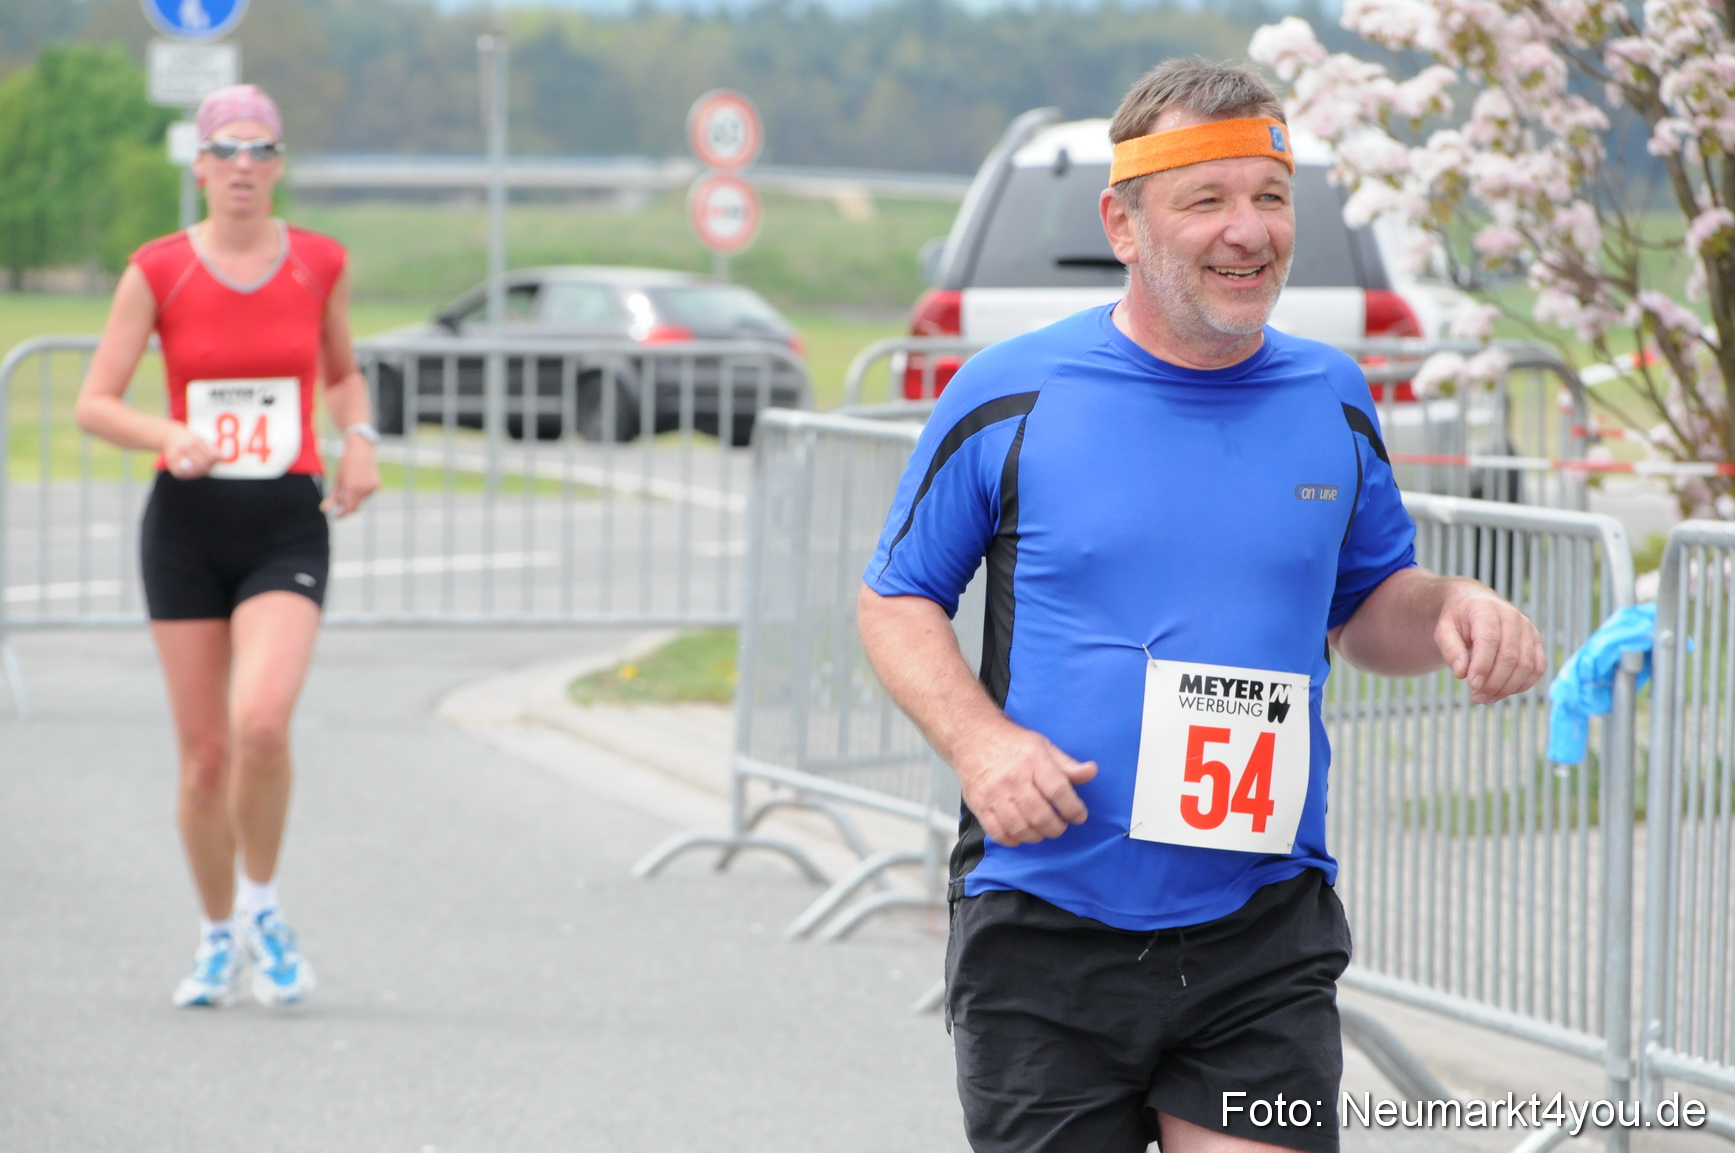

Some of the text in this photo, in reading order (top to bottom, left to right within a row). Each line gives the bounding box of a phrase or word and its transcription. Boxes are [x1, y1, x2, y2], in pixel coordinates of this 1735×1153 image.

[216, 411, 272, 464] 84
[1179, 673, 1264, 701] MEYER
[1179, 695, 1263, 717] WERBUNG
[1180, 724, 1276, 833] 54
